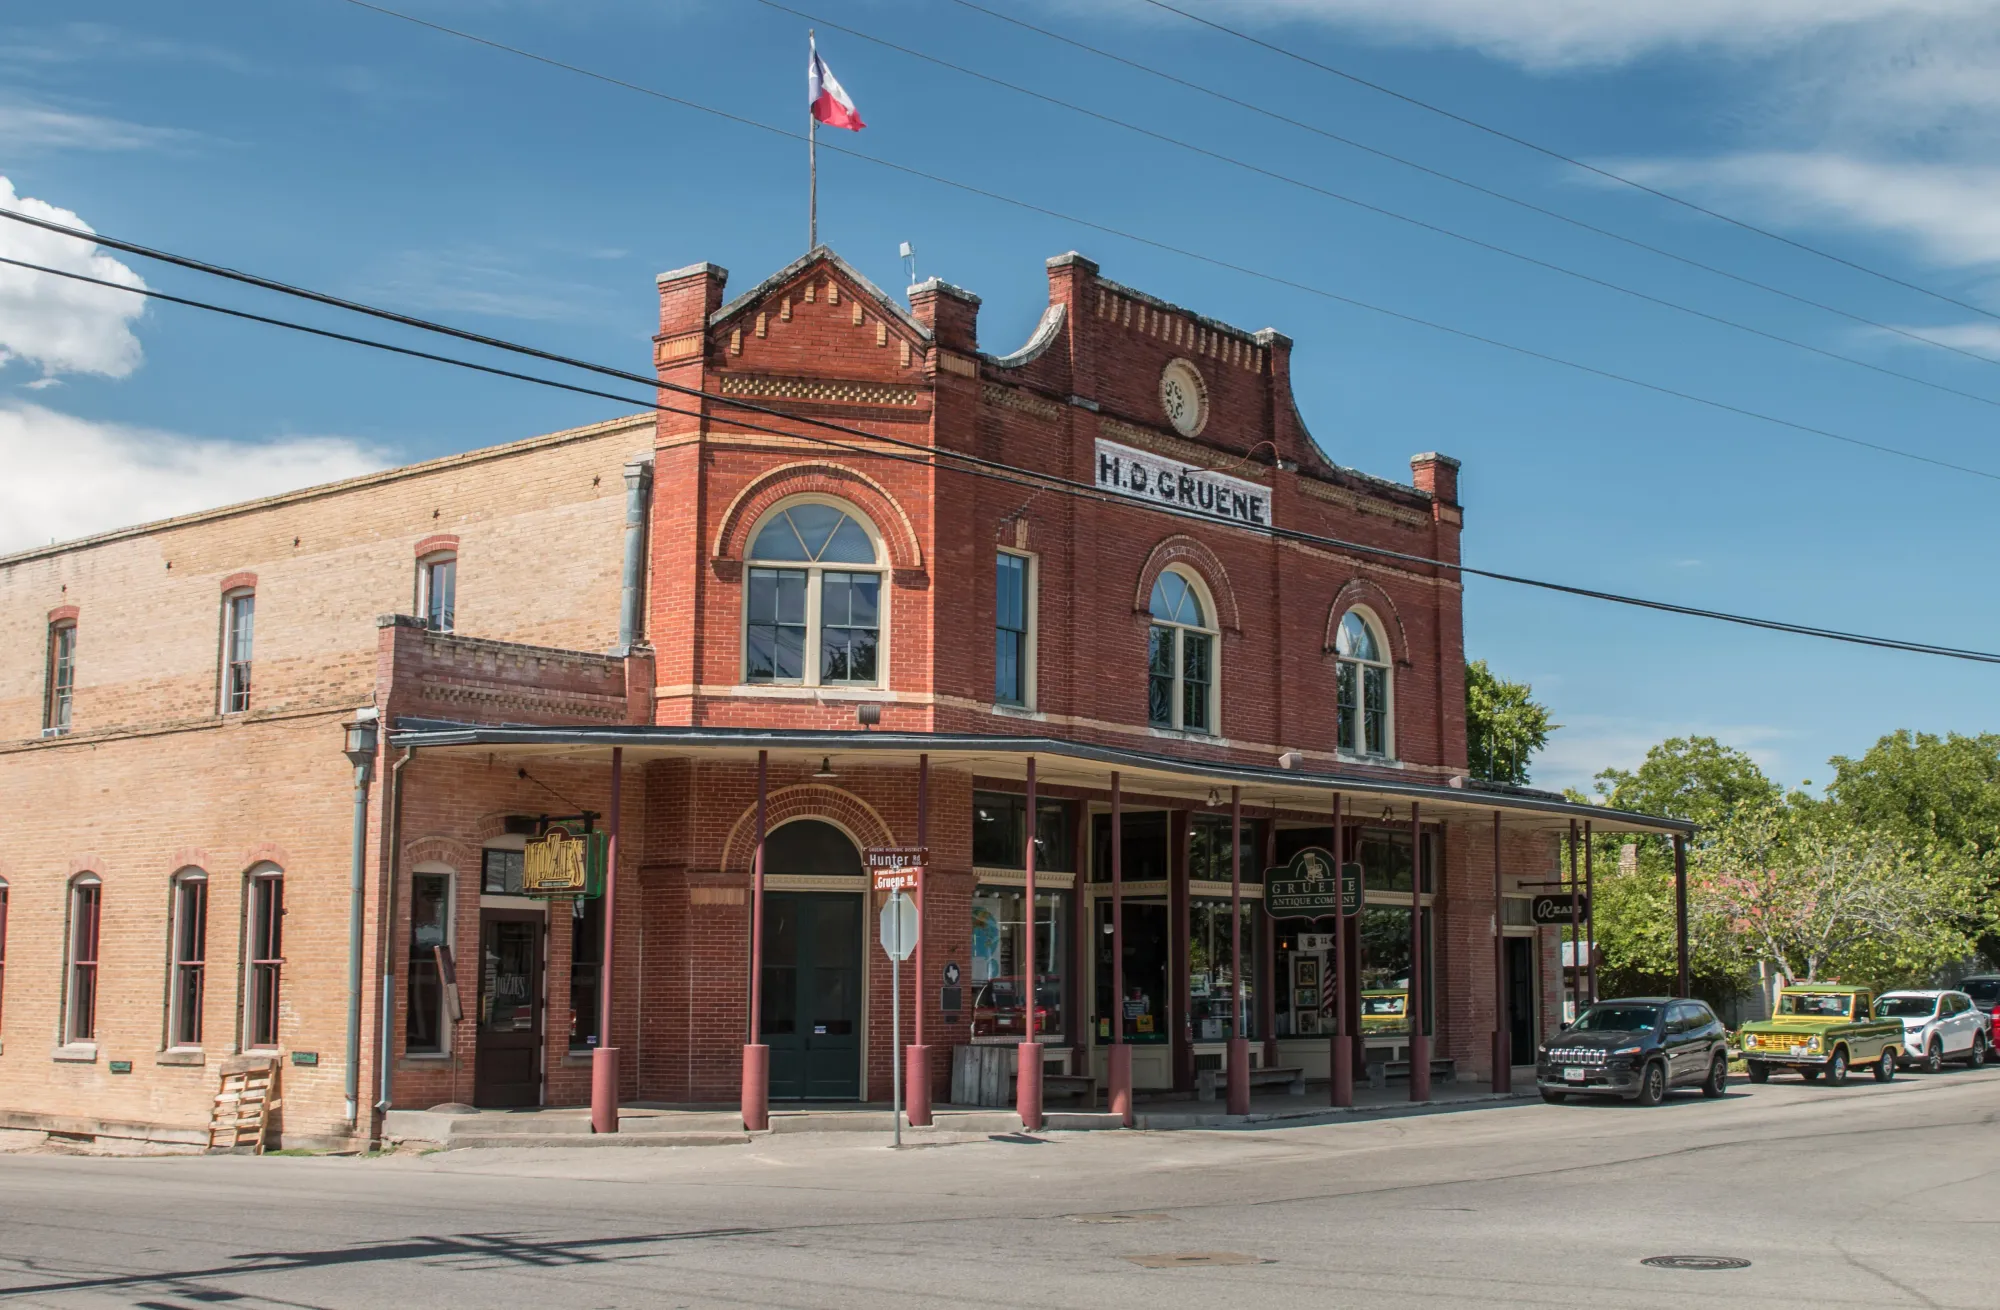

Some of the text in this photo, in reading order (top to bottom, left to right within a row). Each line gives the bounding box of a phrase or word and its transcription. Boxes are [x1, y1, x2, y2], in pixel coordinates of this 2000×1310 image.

[869, 854, 909, 866] Hunter
[877, 876, 905, 889] Gruene
[1272, 896, 1356, 906] ANTIQUE COMNY
